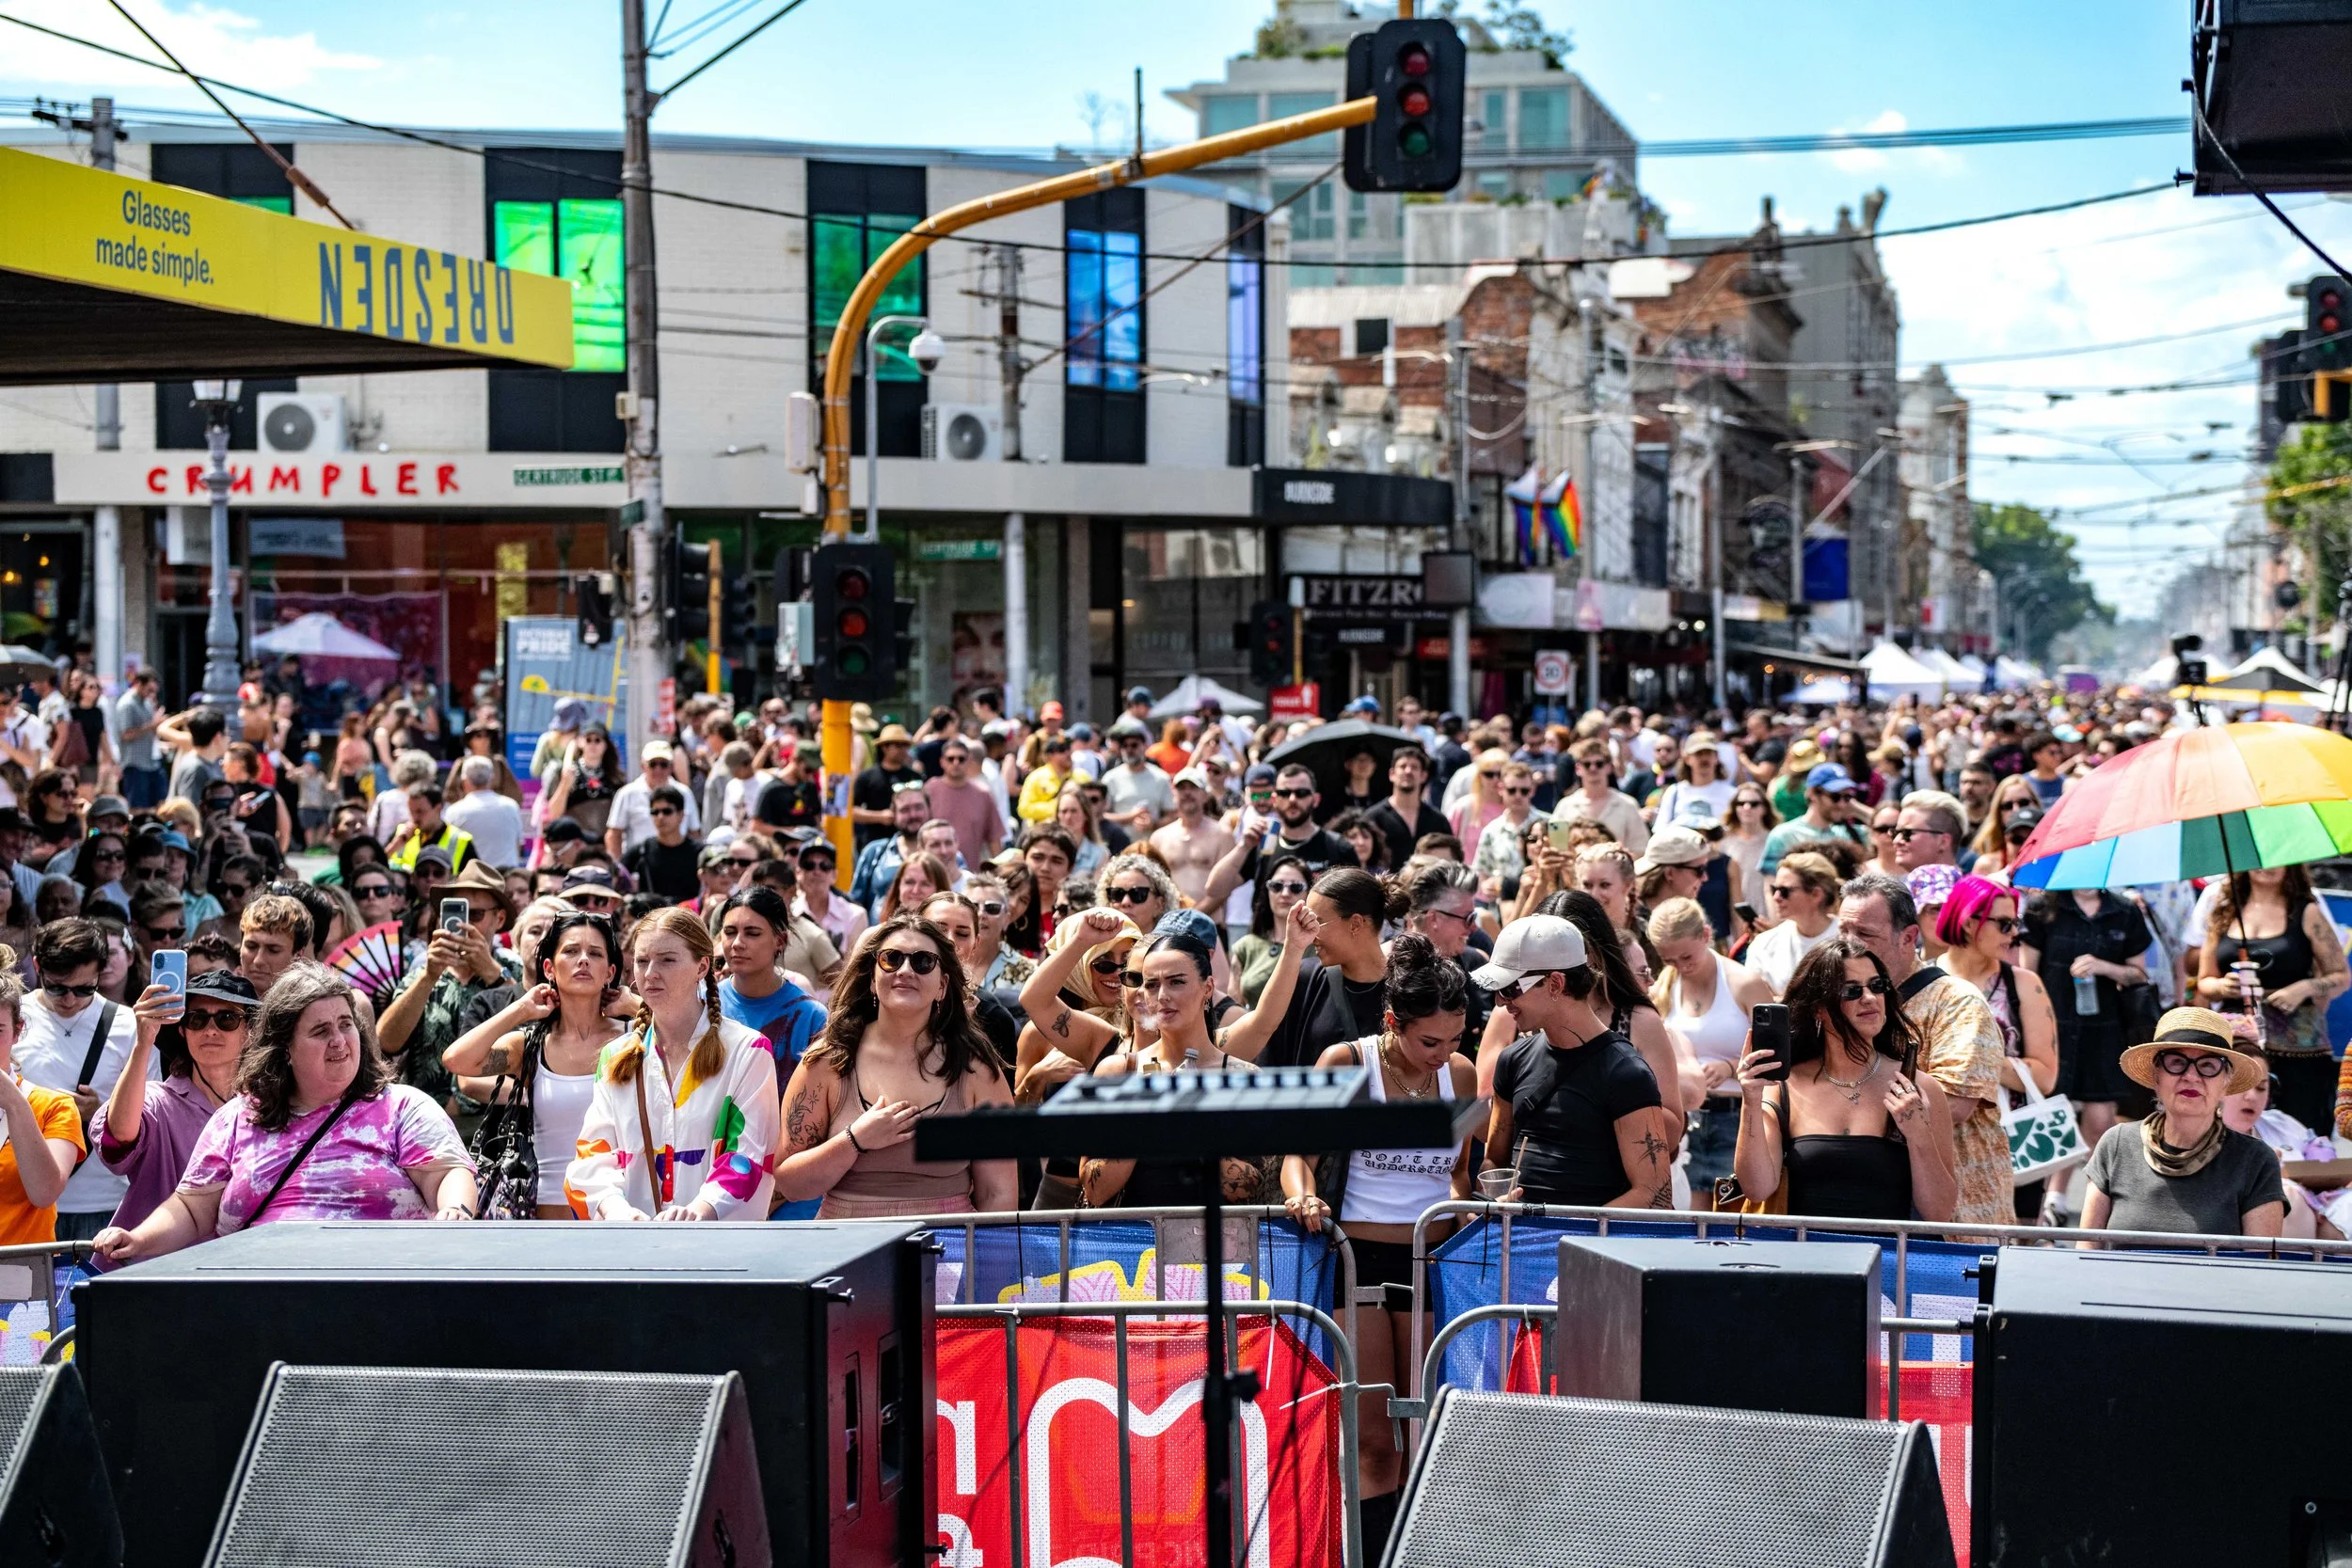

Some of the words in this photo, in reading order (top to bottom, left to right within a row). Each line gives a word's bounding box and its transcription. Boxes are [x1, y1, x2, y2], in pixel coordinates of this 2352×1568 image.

[122, 190, 191, 237] Glasses
[96, 234, 148, 272] made
[151, 241, 215, 288] simple.
[319, 242, 515, 344] DRESDEN
[147, 463, 461, 497] CRUMPLER
[1360, 1149, 1423, 1164] DON'T
